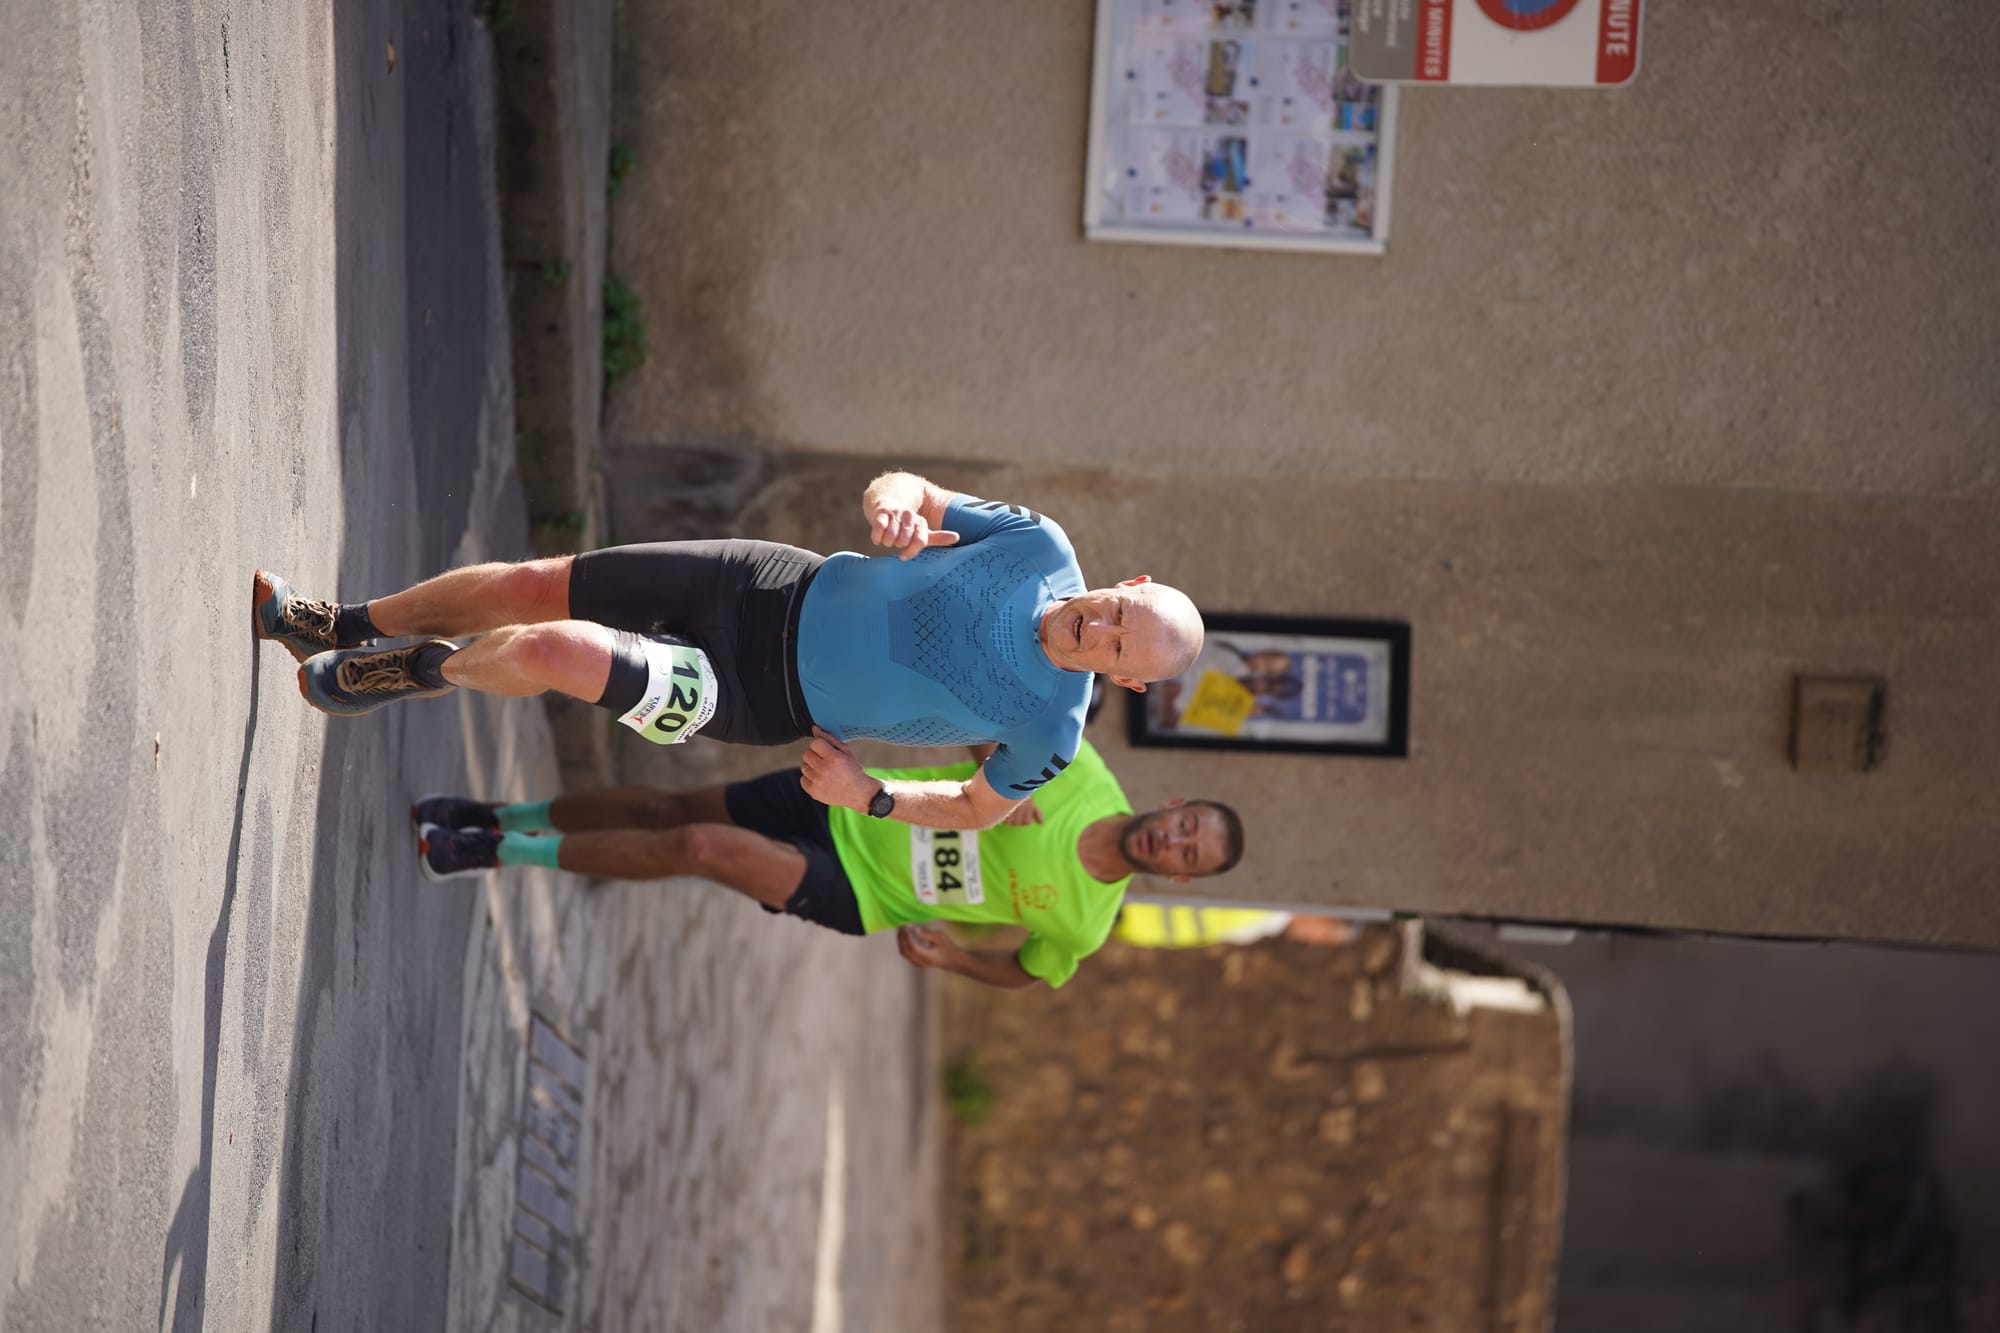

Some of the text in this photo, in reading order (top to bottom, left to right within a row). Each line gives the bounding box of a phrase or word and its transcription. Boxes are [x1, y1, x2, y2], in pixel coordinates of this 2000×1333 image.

[1423, 7, 1444, 77] MINUTES
[655, 660, 699, 733] 120
[933, 830, 963, 893] 184
